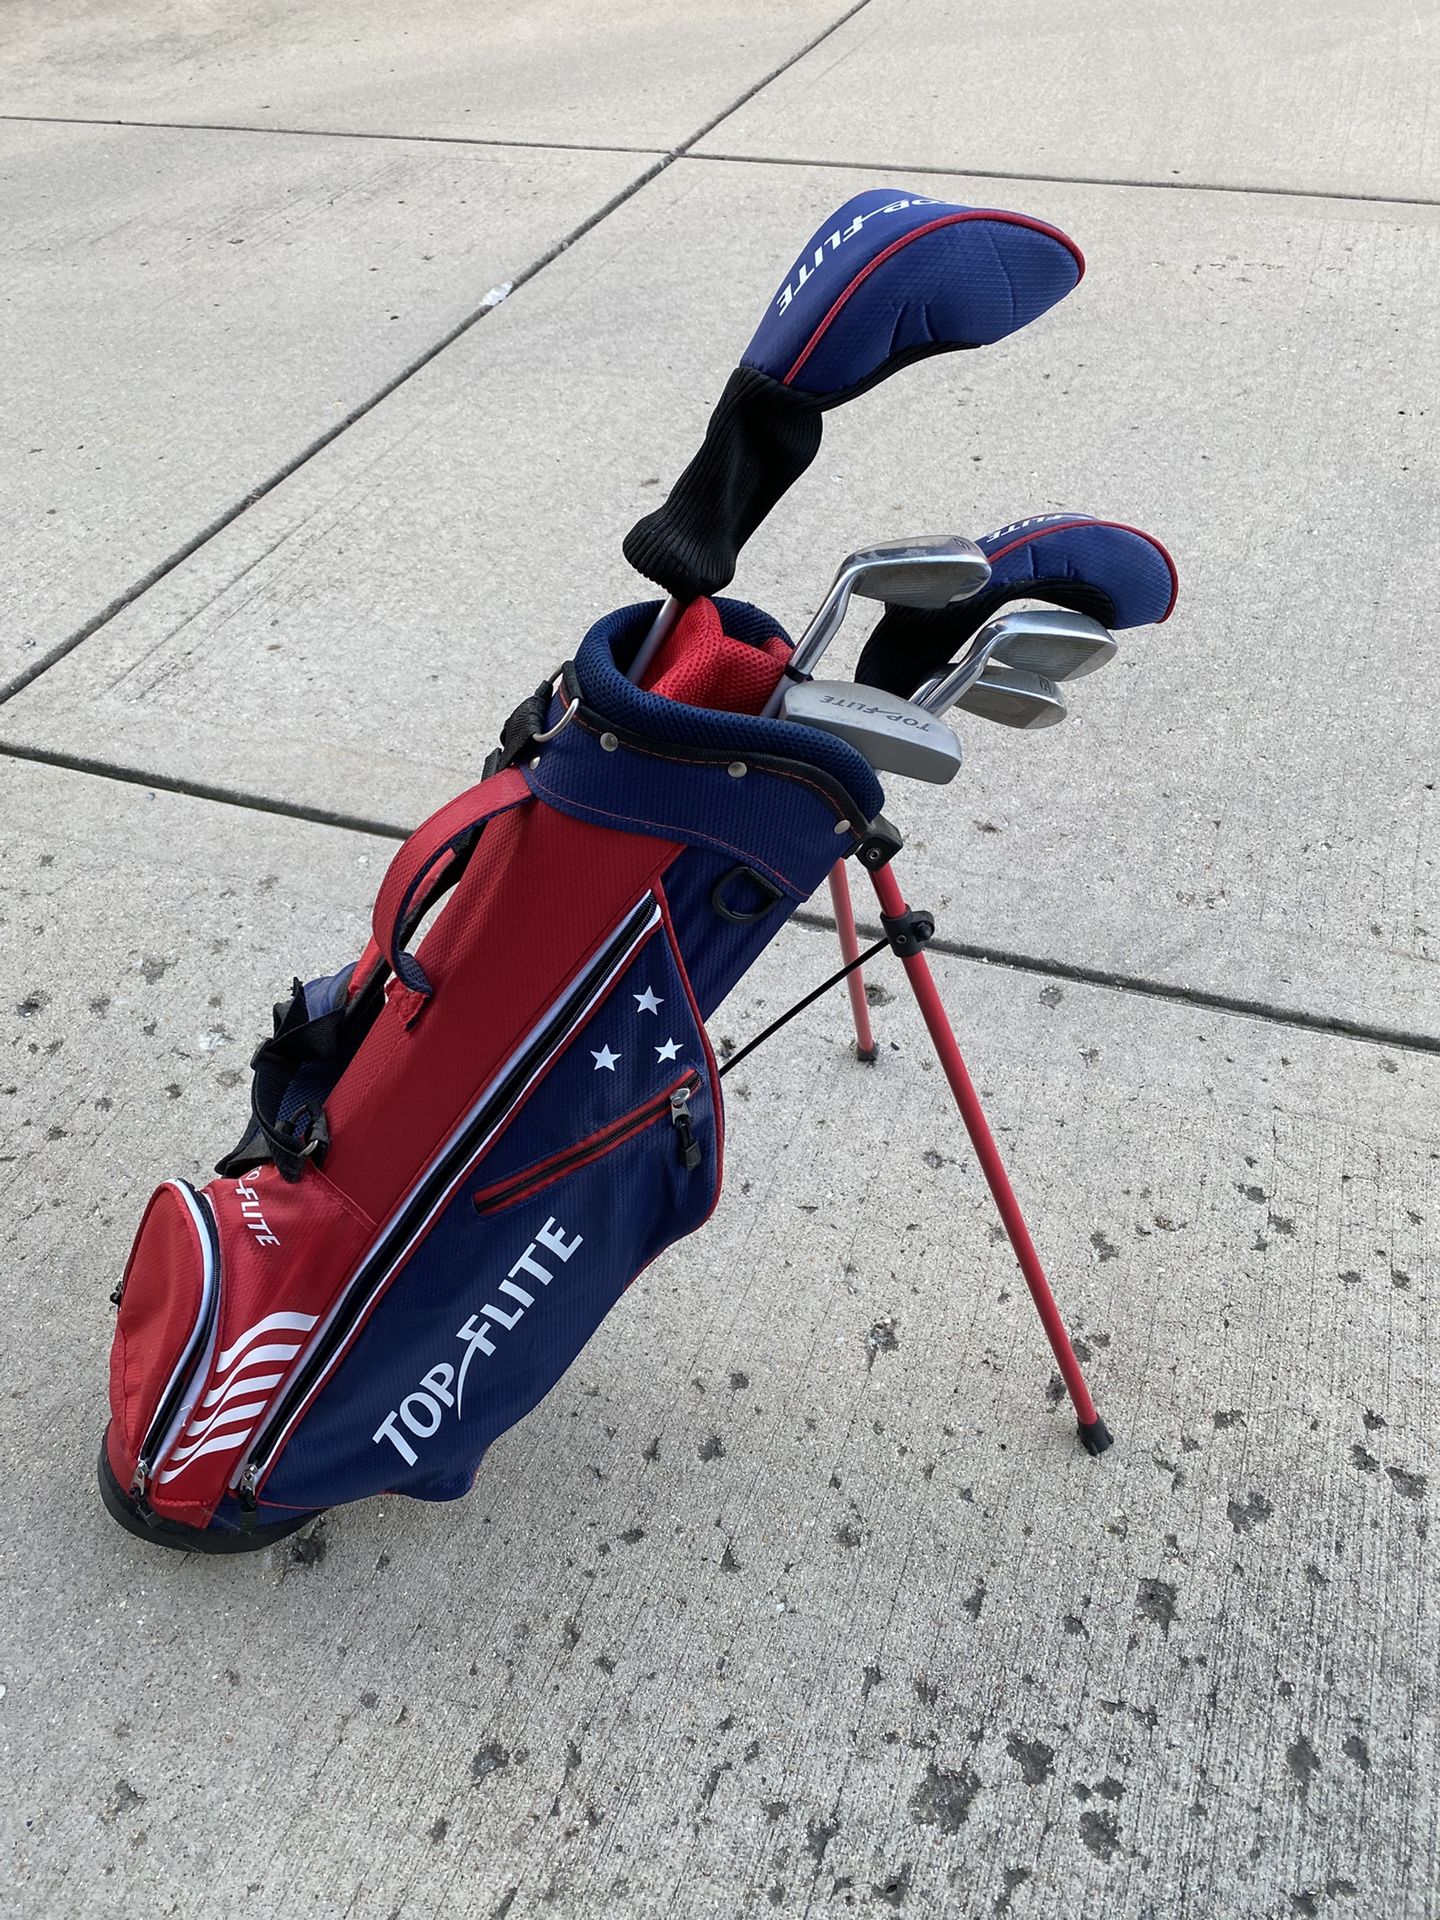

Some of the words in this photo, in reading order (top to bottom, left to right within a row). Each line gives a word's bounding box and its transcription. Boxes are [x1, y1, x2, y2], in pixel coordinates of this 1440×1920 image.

[776, 207, 882, 317] FLITE
[819, 694, 887, 714] FLITE
[886, 714, 931, 733] TOP
[234, 1180, 281, 1247] FLITE
[371, 1362, 456, 1467] TOP
[455, 1215, 584, 1420] FLITE
